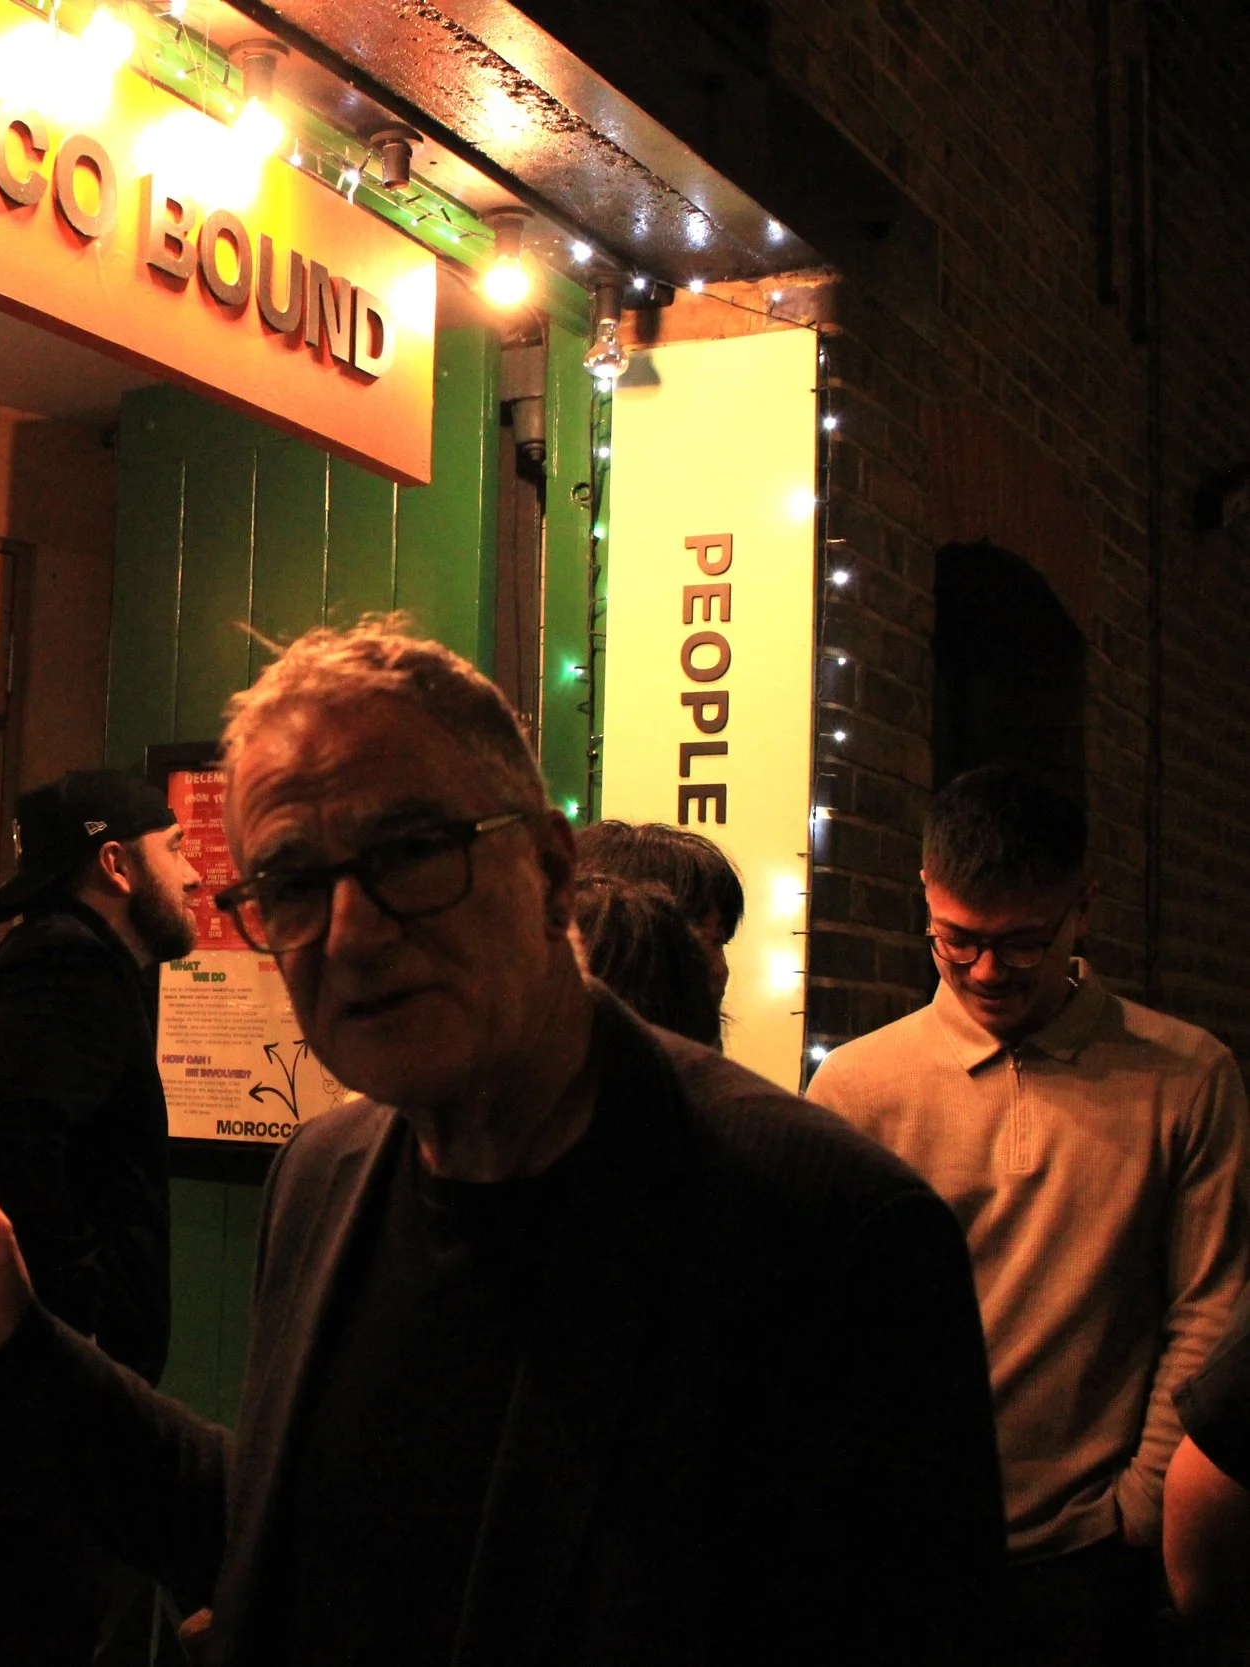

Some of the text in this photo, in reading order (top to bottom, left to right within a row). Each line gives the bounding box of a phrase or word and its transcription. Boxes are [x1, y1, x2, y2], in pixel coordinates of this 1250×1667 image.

[147, 175, 397, 382] BOUND
[677, 532, 733, 825] PEOPLE
[184, 771, 227, 785] DECEM
[170, 960, 201, 972] WHAT
[192, 972, 227, 982] WE DO
[161, 1054, 185, 1065] HOW
[186, 1055, 206, 1065] CAN
